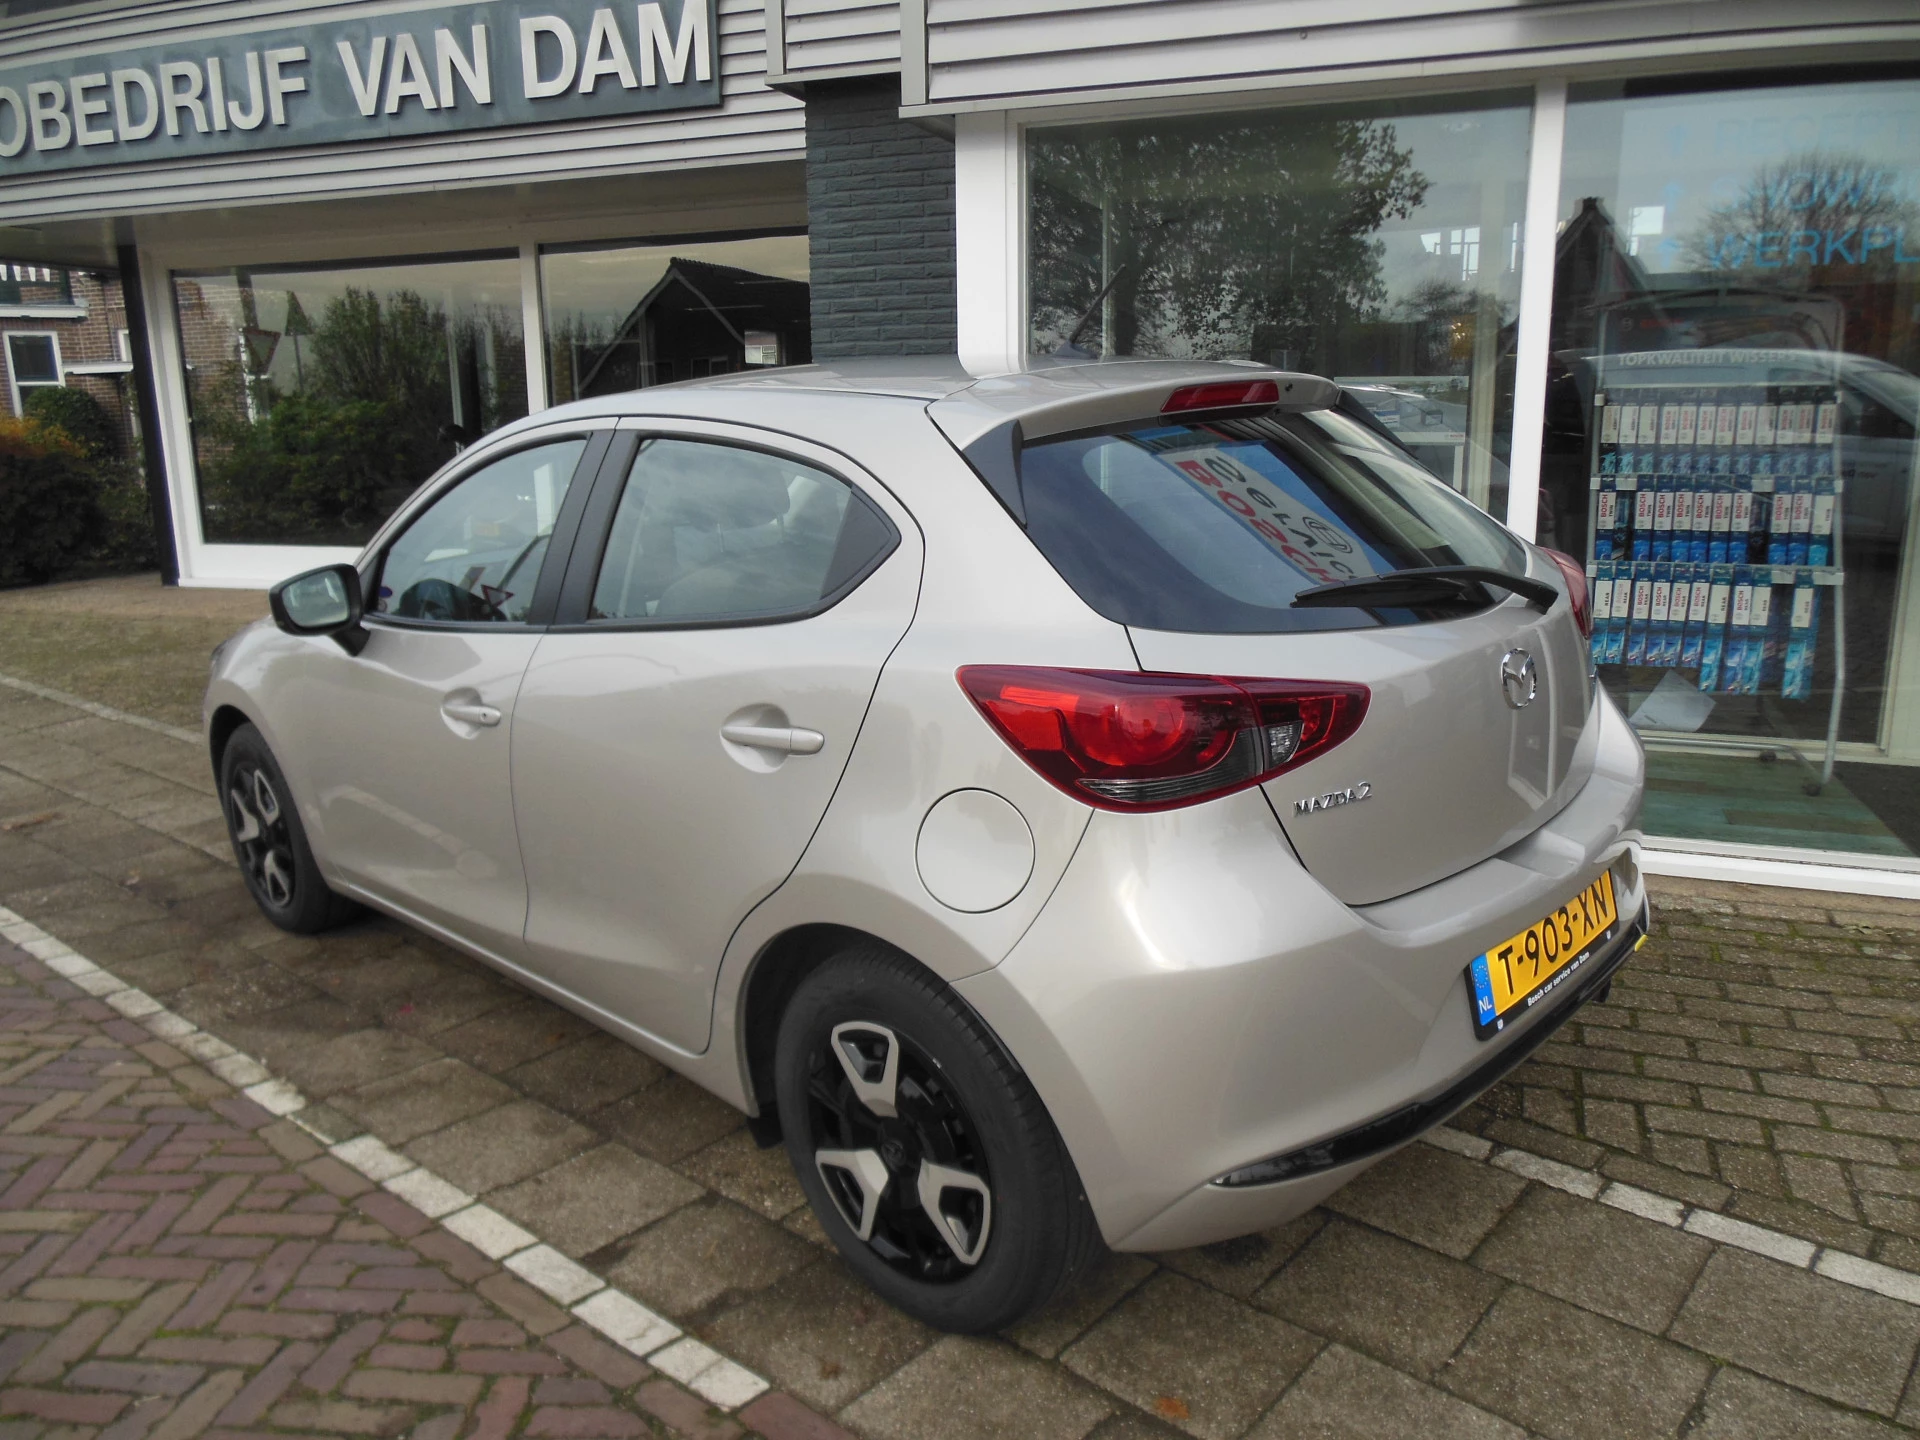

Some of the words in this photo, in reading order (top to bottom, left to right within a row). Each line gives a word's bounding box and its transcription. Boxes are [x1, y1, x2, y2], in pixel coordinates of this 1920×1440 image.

[0, 46, 307, 157] OBEDRIJF
[336, 24, 492, 116] VAN
[519, 0, 711, 99] DAM
[1704, 226, 1920, 269] WERKPL
[1497, 877, 1608, 995] T-903-XN
[1478, 996, 1492, 1014] NL
[1527, 989, 1545, 1006] Bosch
[1544, 982, 1553, 994] car
[1553, 968, 1571, 986] service
[1571, 960, 1580, 971] van
[1579, 951, 1590, 964] Dam
